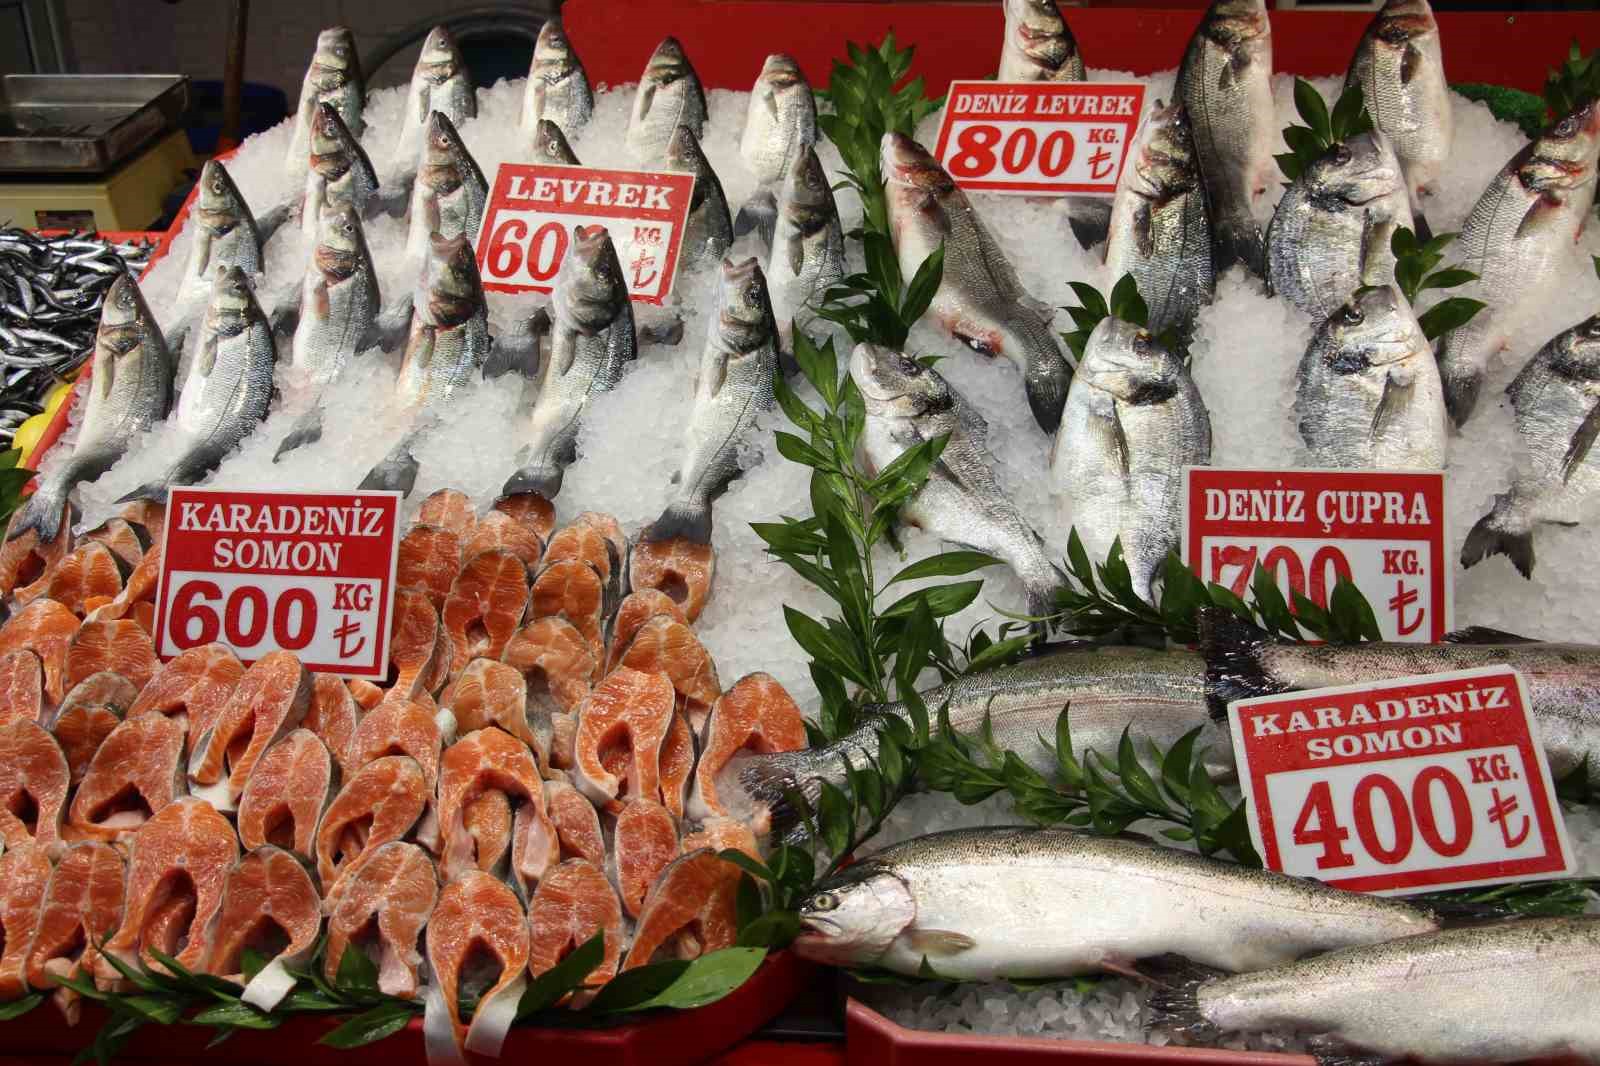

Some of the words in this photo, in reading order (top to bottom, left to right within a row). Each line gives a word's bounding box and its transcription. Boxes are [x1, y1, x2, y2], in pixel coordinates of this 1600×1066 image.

[953, 90, 1029, 114] DENİZ
[1034, 94, 1135, 116] LEVREK
[948, 125, 1075, 178] 800
[1087, 128, 1119, 144] KG.
[506, 175, 675, 210] LEVREK
[487, 219, 609, 281] 60
[178, 499, 385, 537] KARADENİZ
[1204, 479, 1305, 523] DENİZ
[1316, 489, 1431, 533] ÇUPRA
[213, 538, 342, 571] SOMON
[1382, 549, 1424, 575] KG.
[169, 580, 318, 651] 600
[331, 583, 373, 611] KG
[1250, 684, 1510, 737] KARADENİZ
[1306, 722, 1463, 761] SOMON
[1467, 754, 1519, 784] KG.
[1292, 765, 1474, 870] 400
